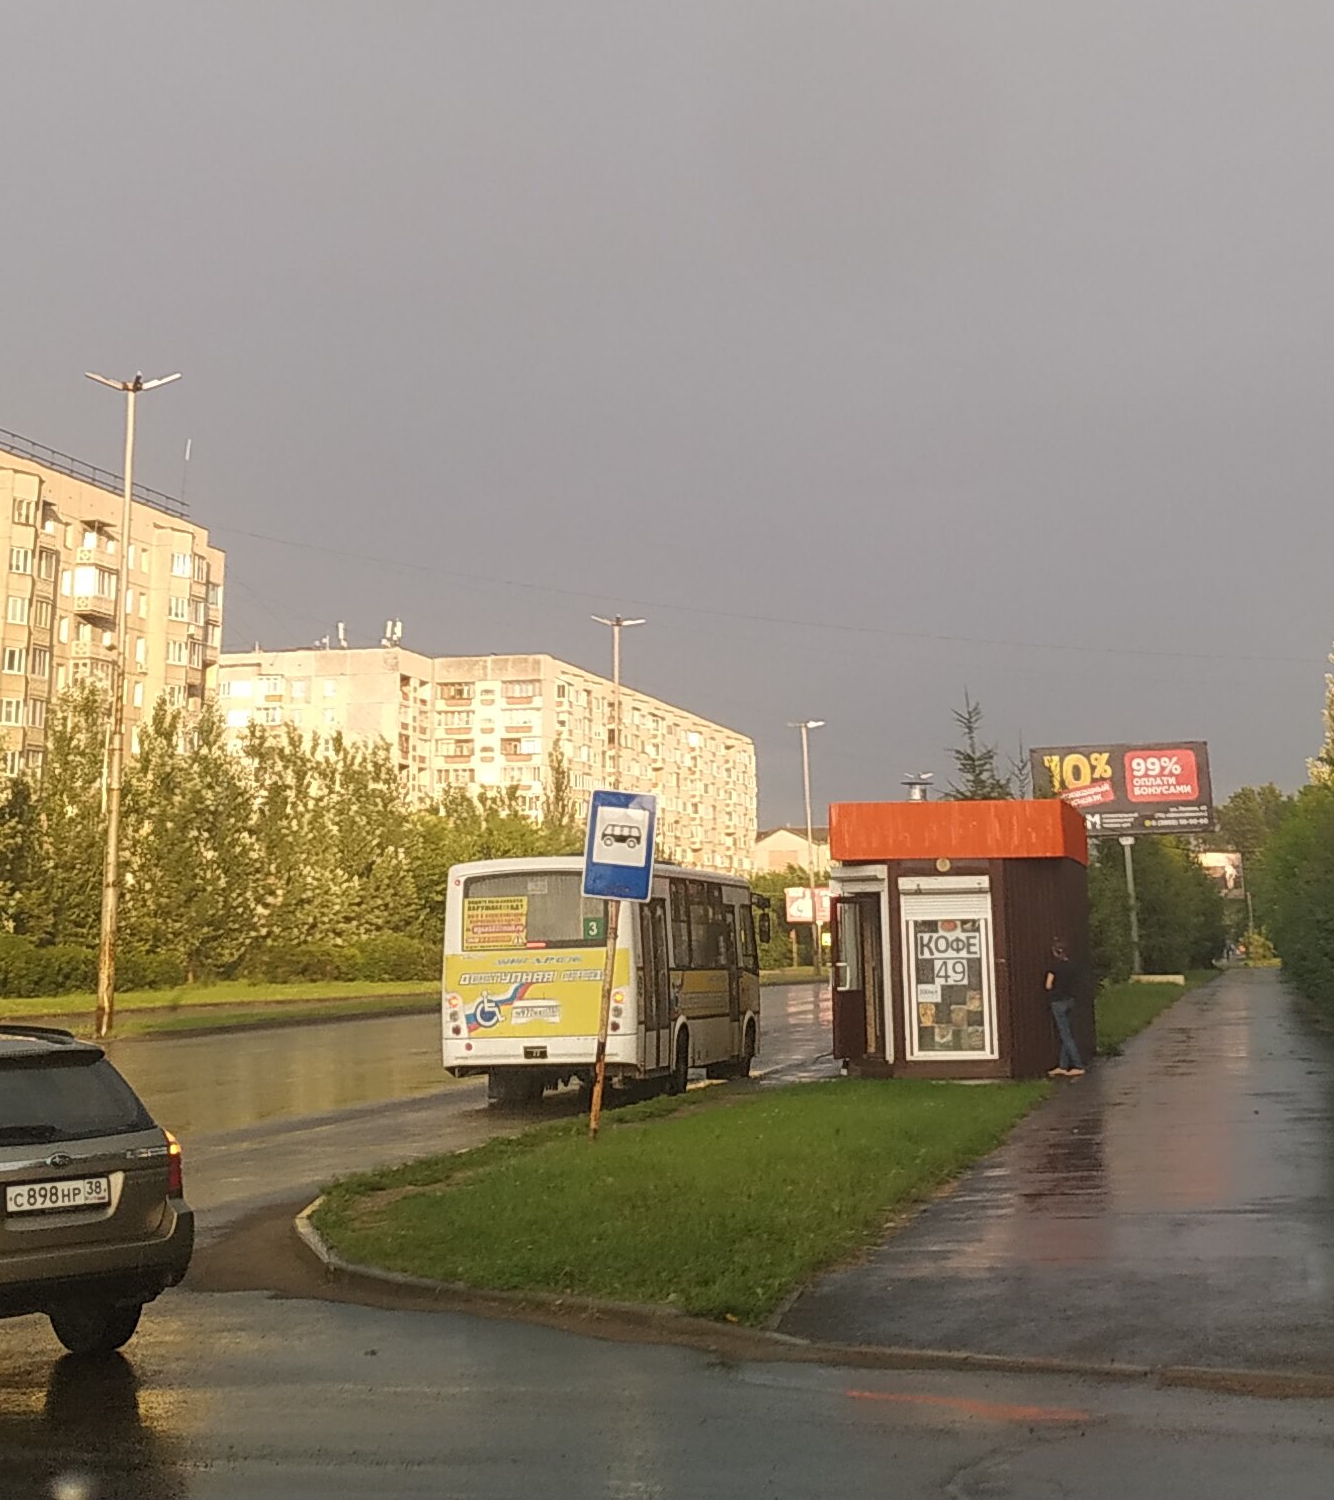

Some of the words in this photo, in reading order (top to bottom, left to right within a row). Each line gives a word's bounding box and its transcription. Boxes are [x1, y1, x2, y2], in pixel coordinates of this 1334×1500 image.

[1131, 756, 1182, 777] 99%
[1133, 777, 1176, 786] ОПЛАТИ
[1133, 784, 1192, 796] БОНУСАМИ
[589, 922, 597, 936] 3
[919, 935, 978, 957] КОФЕ
[935, 960, 966, 983] 49
